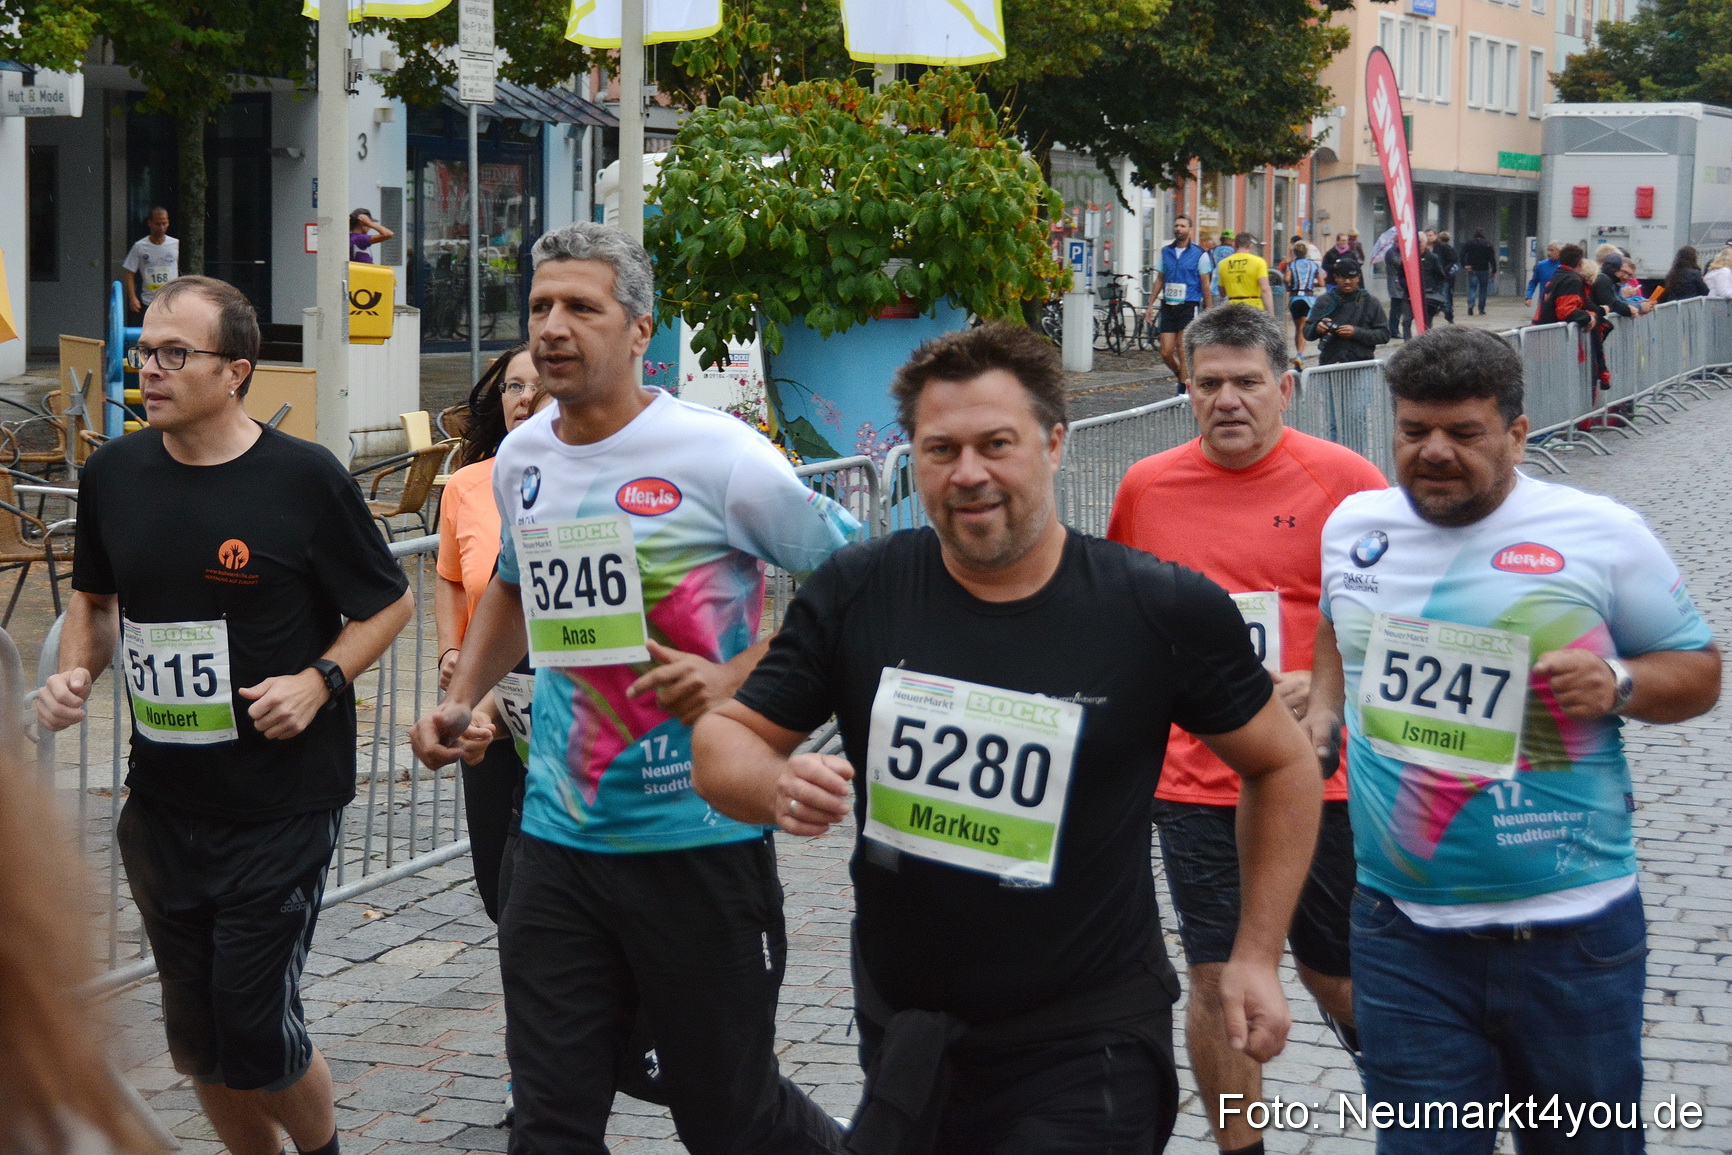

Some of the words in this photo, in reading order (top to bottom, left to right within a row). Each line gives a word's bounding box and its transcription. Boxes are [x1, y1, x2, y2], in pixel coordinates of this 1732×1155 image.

[8, 89, 25, 102] Hut
[28, 89, 35, 102] &
[40, 89, 64, 102] Mode
[358, 132, 368, 160] 3
[1071, 245, 1082, 260] P
[624, 486, 675, 507] Hervis
[557, 521, 620, 543] BOCK
[1500, 551, 1557, 568] Hervis
[529, 553, 627, 611] 5246
[1343, 572, 1379, 584] PARTL
[150, 626, 215, 643] BOCK
[562, 626, 596, 645] Anas
[1384, 629, 1430, 643] NeuerMarkt
[1436, 626, 1513, 655] BOCK
[128, 648, 218, 698] 5115
[1379, 650, 1511, 719] 5247
[892, 690, 955, 709] NeuerMarkt
[964, 690, 1062, 728] BOCK
[146, 706, 199, 727] Norbert
[1401, 720, 1466, 751] Ismail
[640, 734, 679, 762] 17.
[887, 715, 1051, 808] 5280
[1487, 780, 1533, 810] 17.
[908, 802, 1001, 846] Markus
[1492, 810, 1584, 828] Neumarkter
[1495, 826, 1568, 846] Stadtlauf
